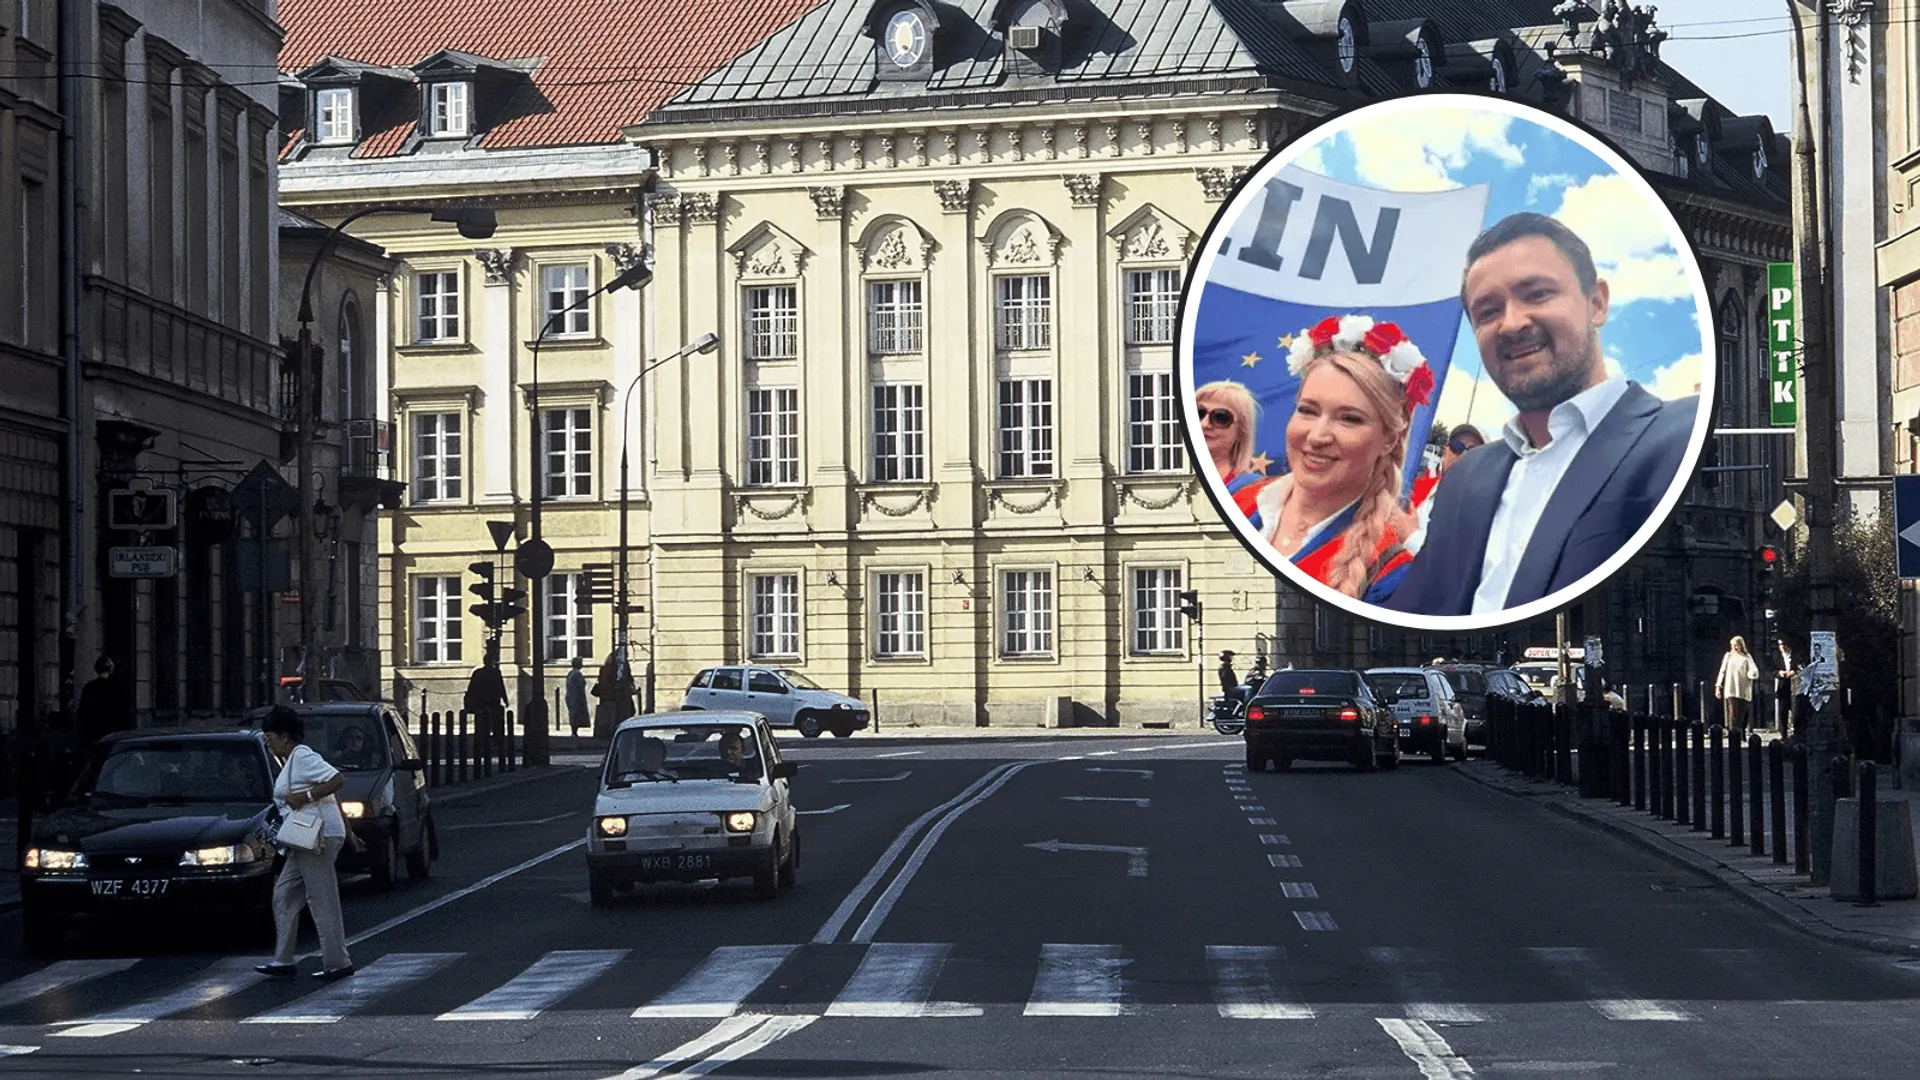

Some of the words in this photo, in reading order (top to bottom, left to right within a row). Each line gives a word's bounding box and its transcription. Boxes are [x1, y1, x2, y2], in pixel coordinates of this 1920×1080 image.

[1217, 177, 1401, 285] IN
[1771, 288, 1794, 403] PTTK
[131, 563, 150, 571] PUB
[641, 856, 671, 869] WXB
[678, 855, 711, 869] 2881
[91, 880, 123, 895] WZF
[131, 880, 169, 894] 4377
